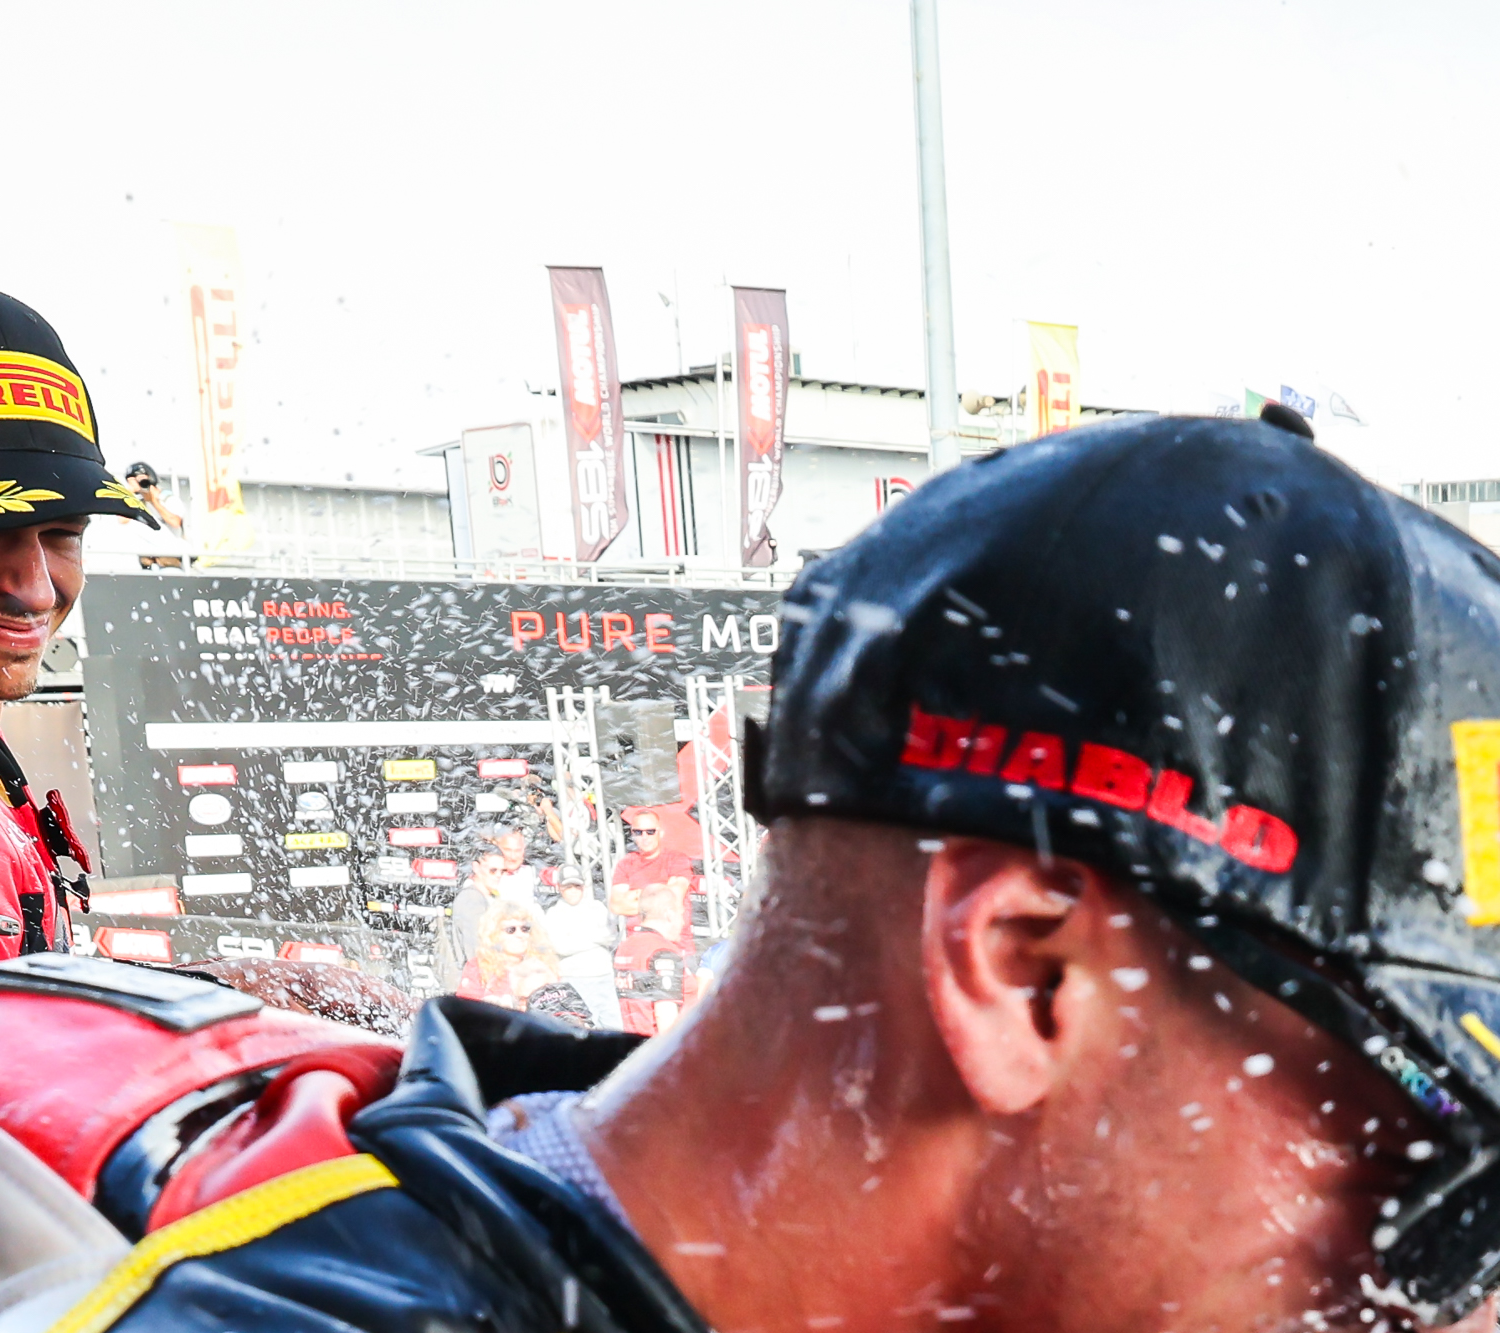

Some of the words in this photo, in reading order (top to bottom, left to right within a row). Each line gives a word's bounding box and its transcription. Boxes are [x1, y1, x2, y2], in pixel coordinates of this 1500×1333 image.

[568, 309, 598, 407] MOTUL
[747, 328, 773, 422] MOTUL
[192, 599, 258, 619] REAL
[196, 626, 261, 645] REAL
[510, 611, 677, 654] PURE
[899, 702, 1299, 877] DIABLO
